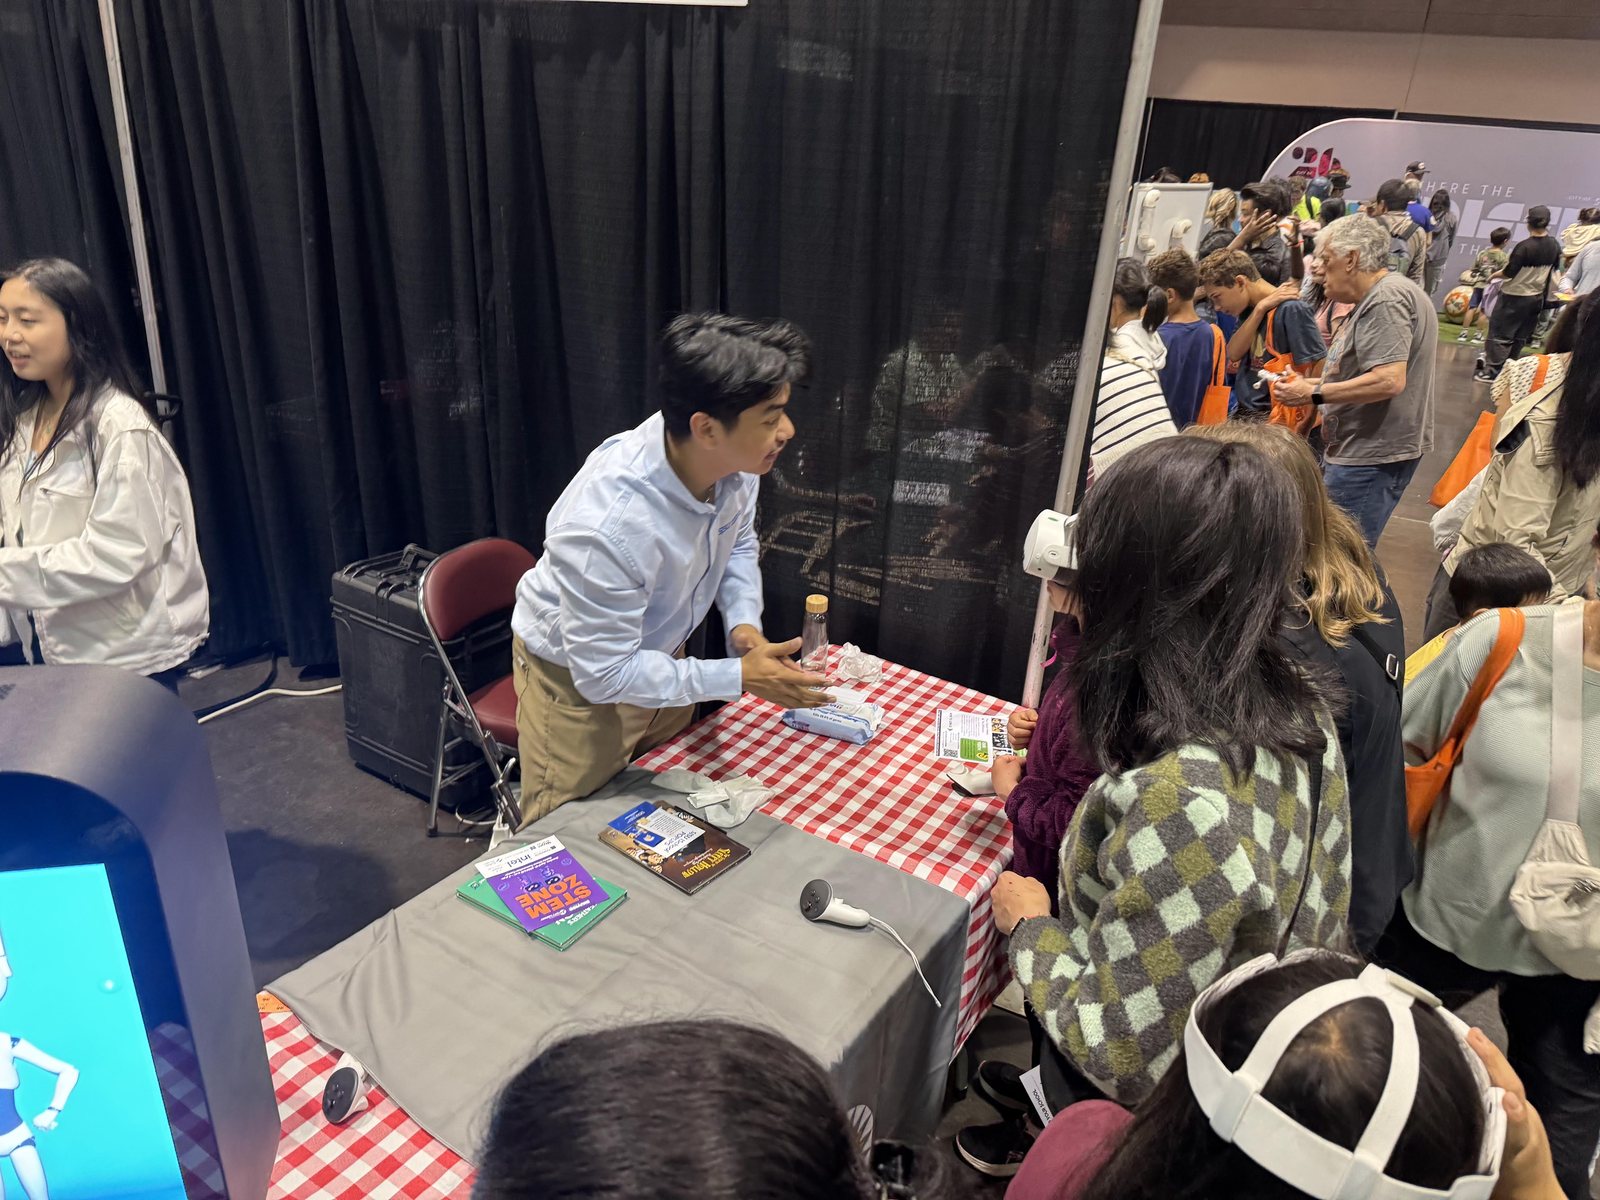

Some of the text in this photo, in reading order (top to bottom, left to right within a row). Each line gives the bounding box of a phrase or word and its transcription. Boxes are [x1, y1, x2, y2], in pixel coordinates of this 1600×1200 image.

[1480, 184, 1515, 198] THE
[507, 854, 532, 868] intel
[515, 873, 583, 908] ZONE
[525, 885, 592, 919] STEM
